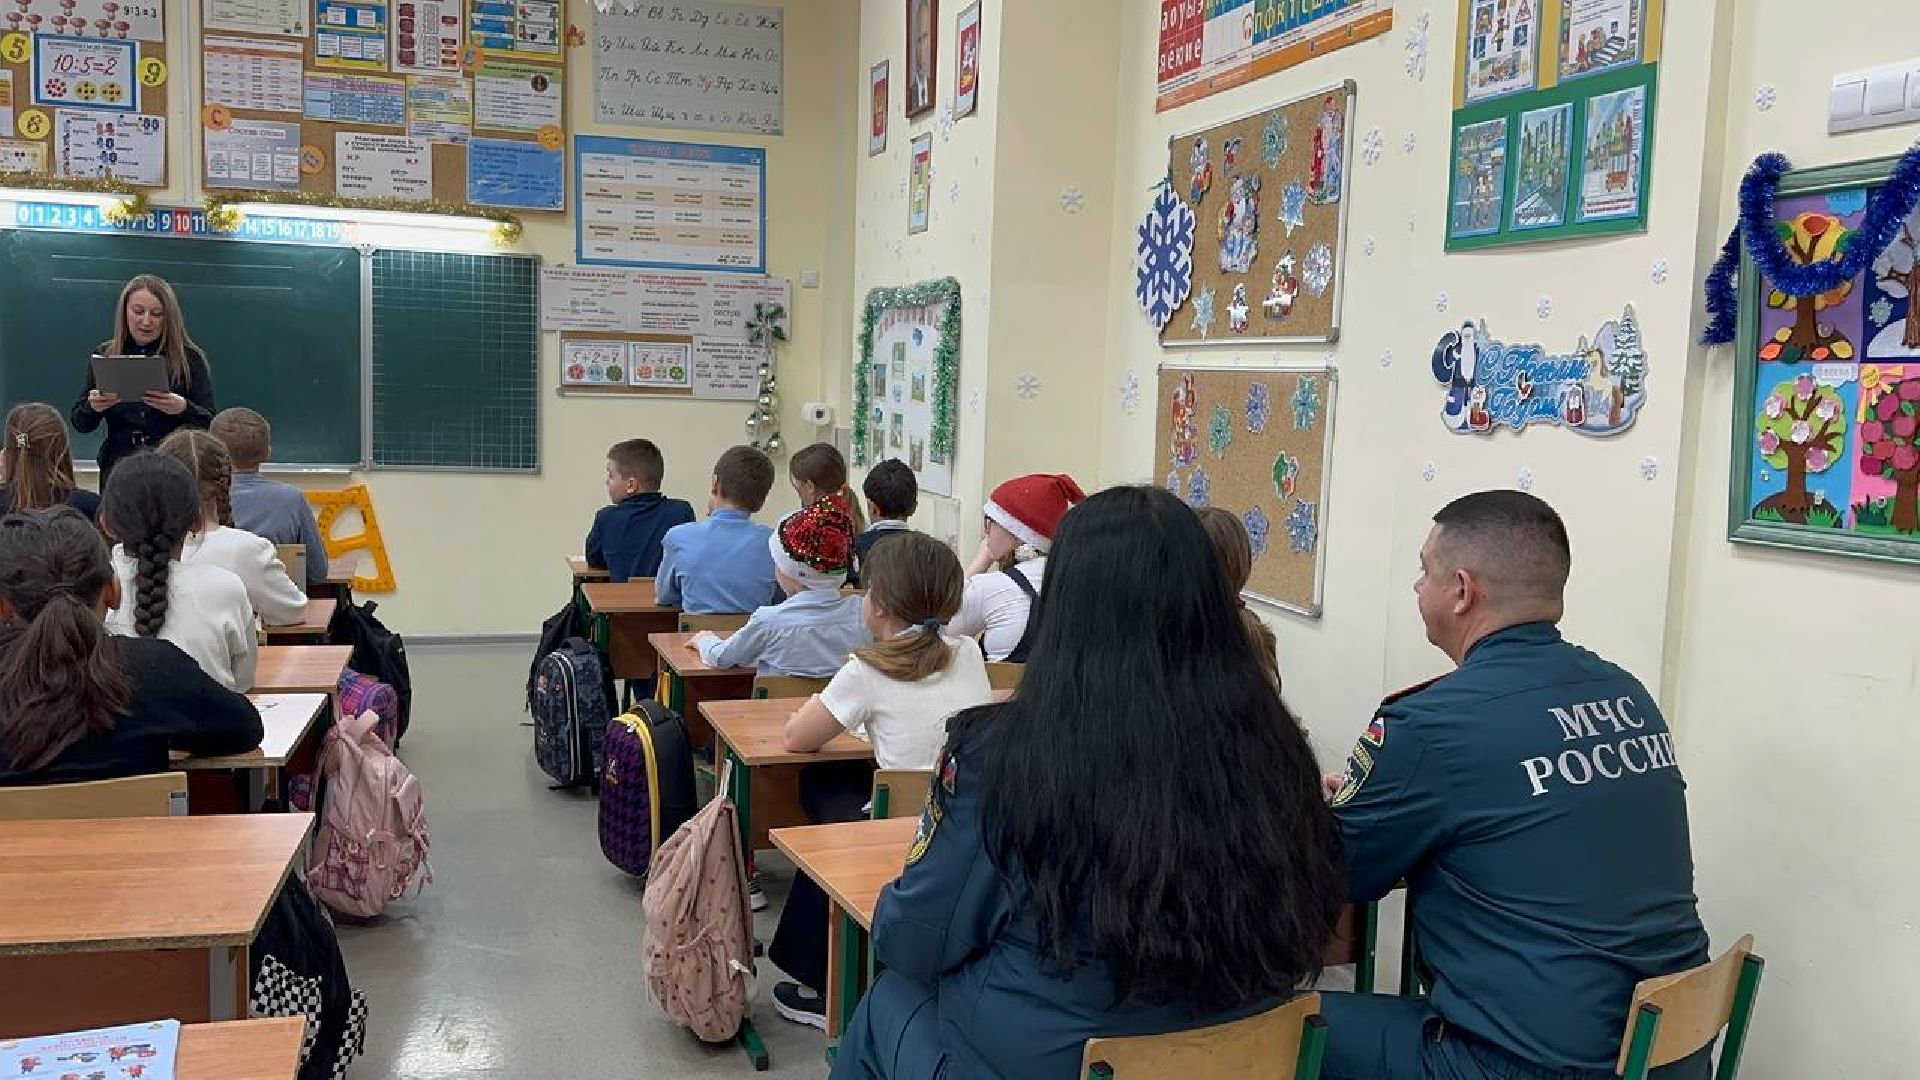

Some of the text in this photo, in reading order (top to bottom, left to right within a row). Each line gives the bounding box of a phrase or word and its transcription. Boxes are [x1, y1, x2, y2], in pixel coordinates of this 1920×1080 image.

[146, 213, 155, 229] 8
[162, 214, 171, 230] 9
[176, 215, 190, 231] 10
[192, 215, 206, 232] 11
[1547, 696, 1645, 741] МЧС
